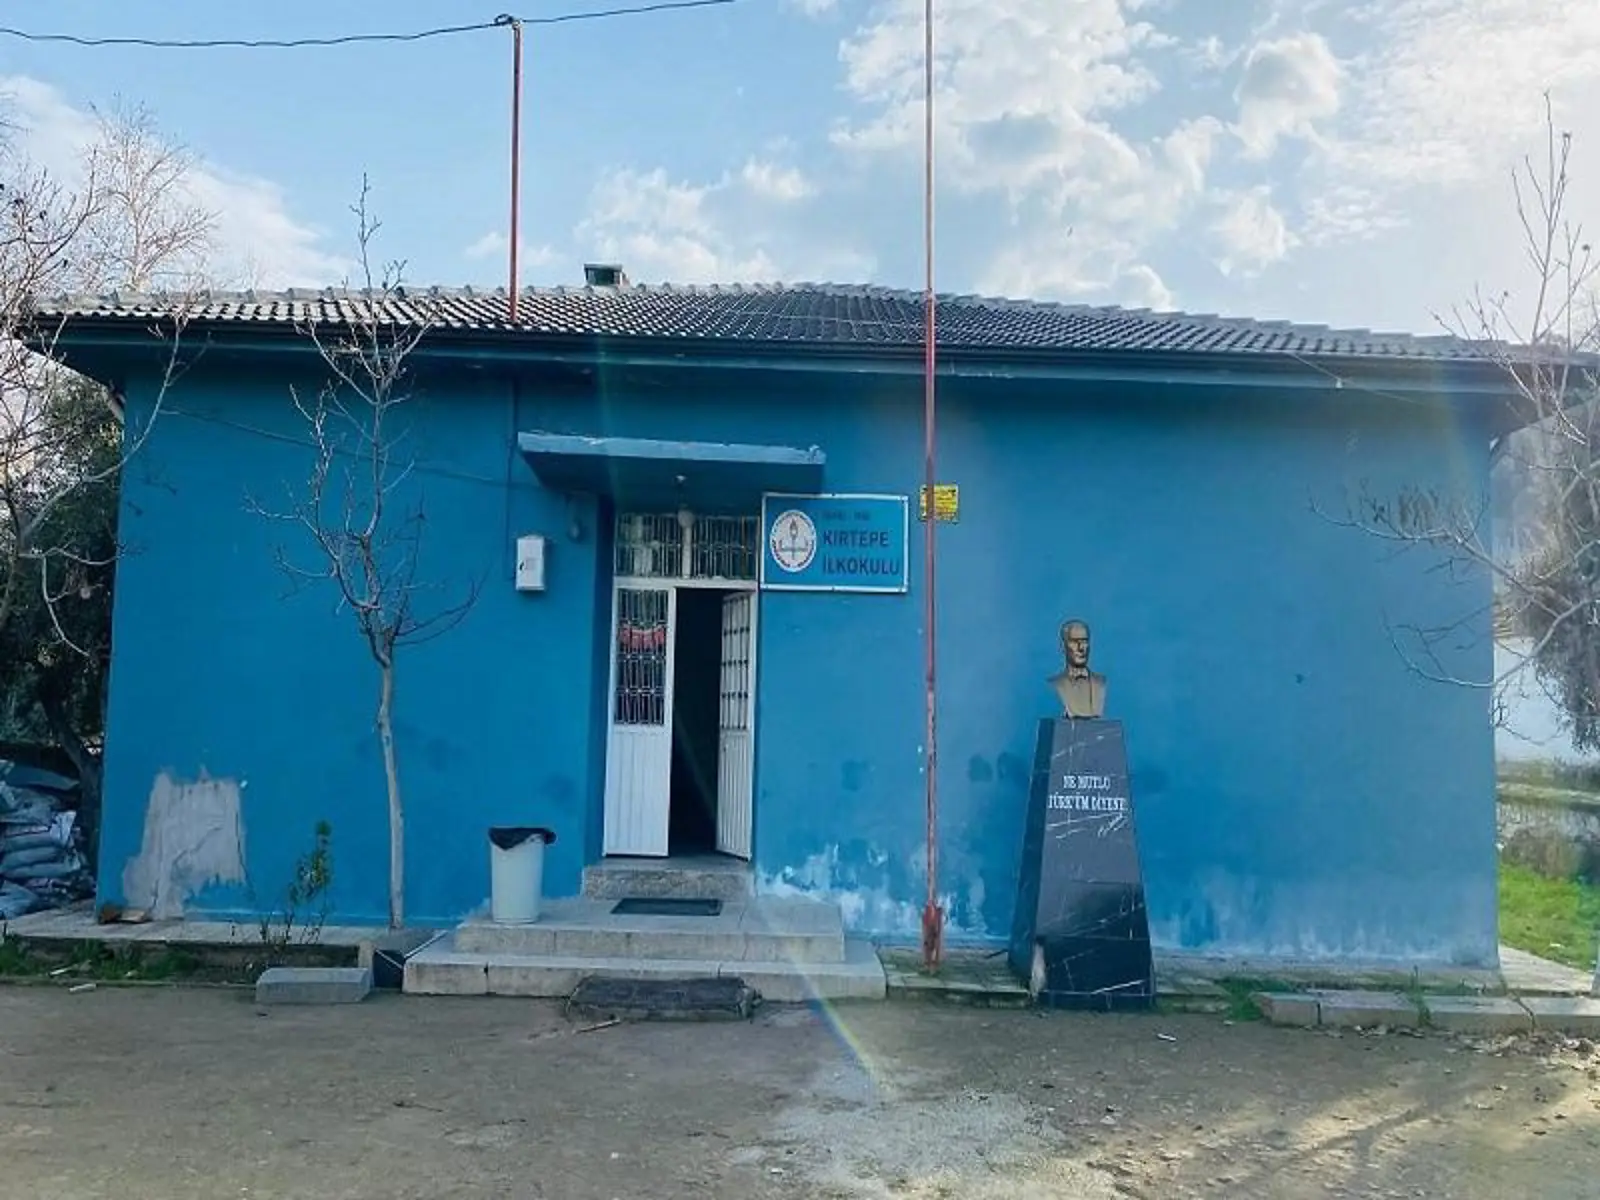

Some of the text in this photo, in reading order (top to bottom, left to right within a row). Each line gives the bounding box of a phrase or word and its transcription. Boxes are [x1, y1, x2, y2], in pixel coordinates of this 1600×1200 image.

[823, 530, 889, 547] KIRTEPE
[822, 553, 900, 576] İLKOKULU
[1063, 775, 1077, 789] NE
